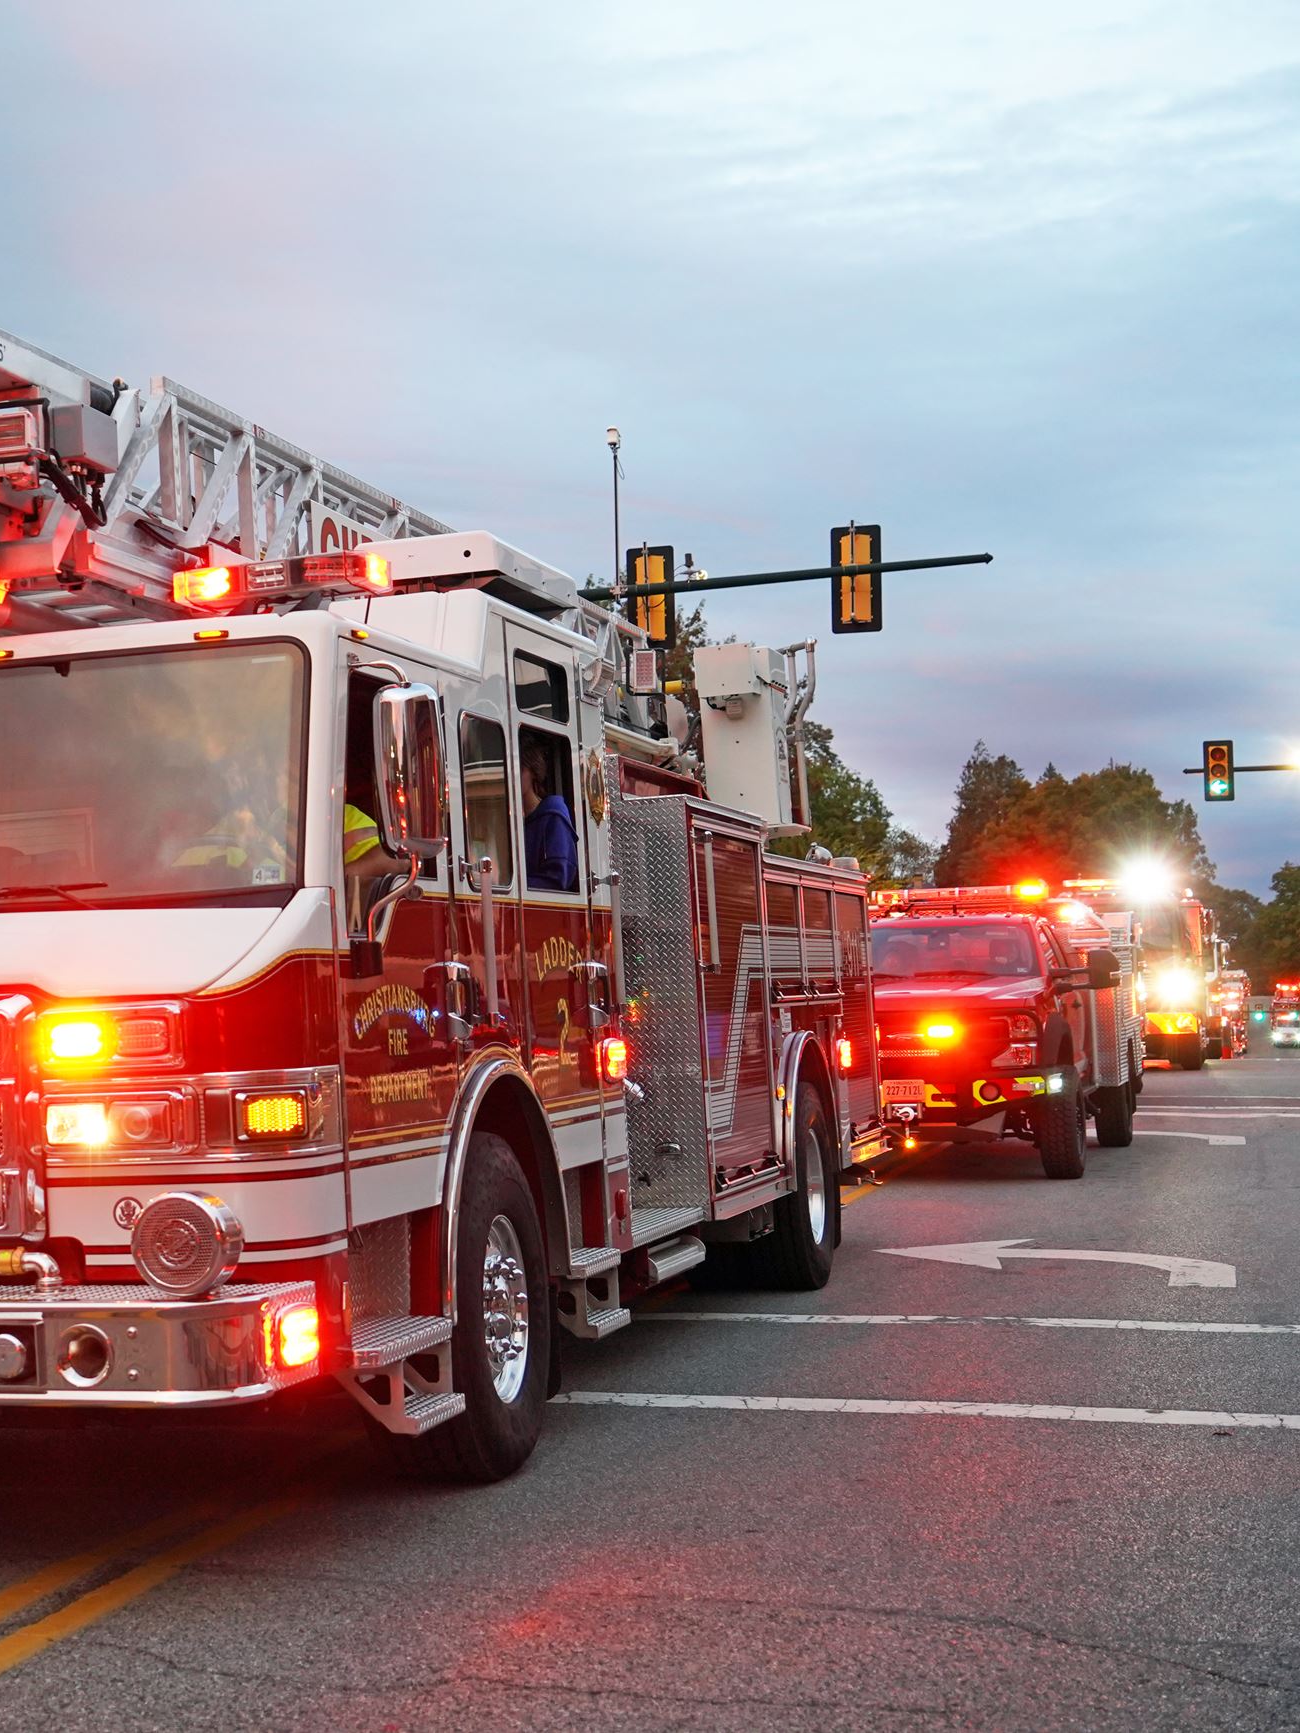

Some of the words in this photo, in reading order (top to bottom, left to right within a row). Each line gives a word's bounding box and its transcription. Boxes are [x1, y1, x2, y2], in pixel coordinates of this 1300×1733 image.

[535, 936, 582, 984] LADDER
[354, 985, 436, 1039] CHRISTIANSBURG
[557, 998, 578, 1065] 2
[388, 1028, 409, 1055] FIRE
[369, 1069, 429, 1104] DEPARTMENT
